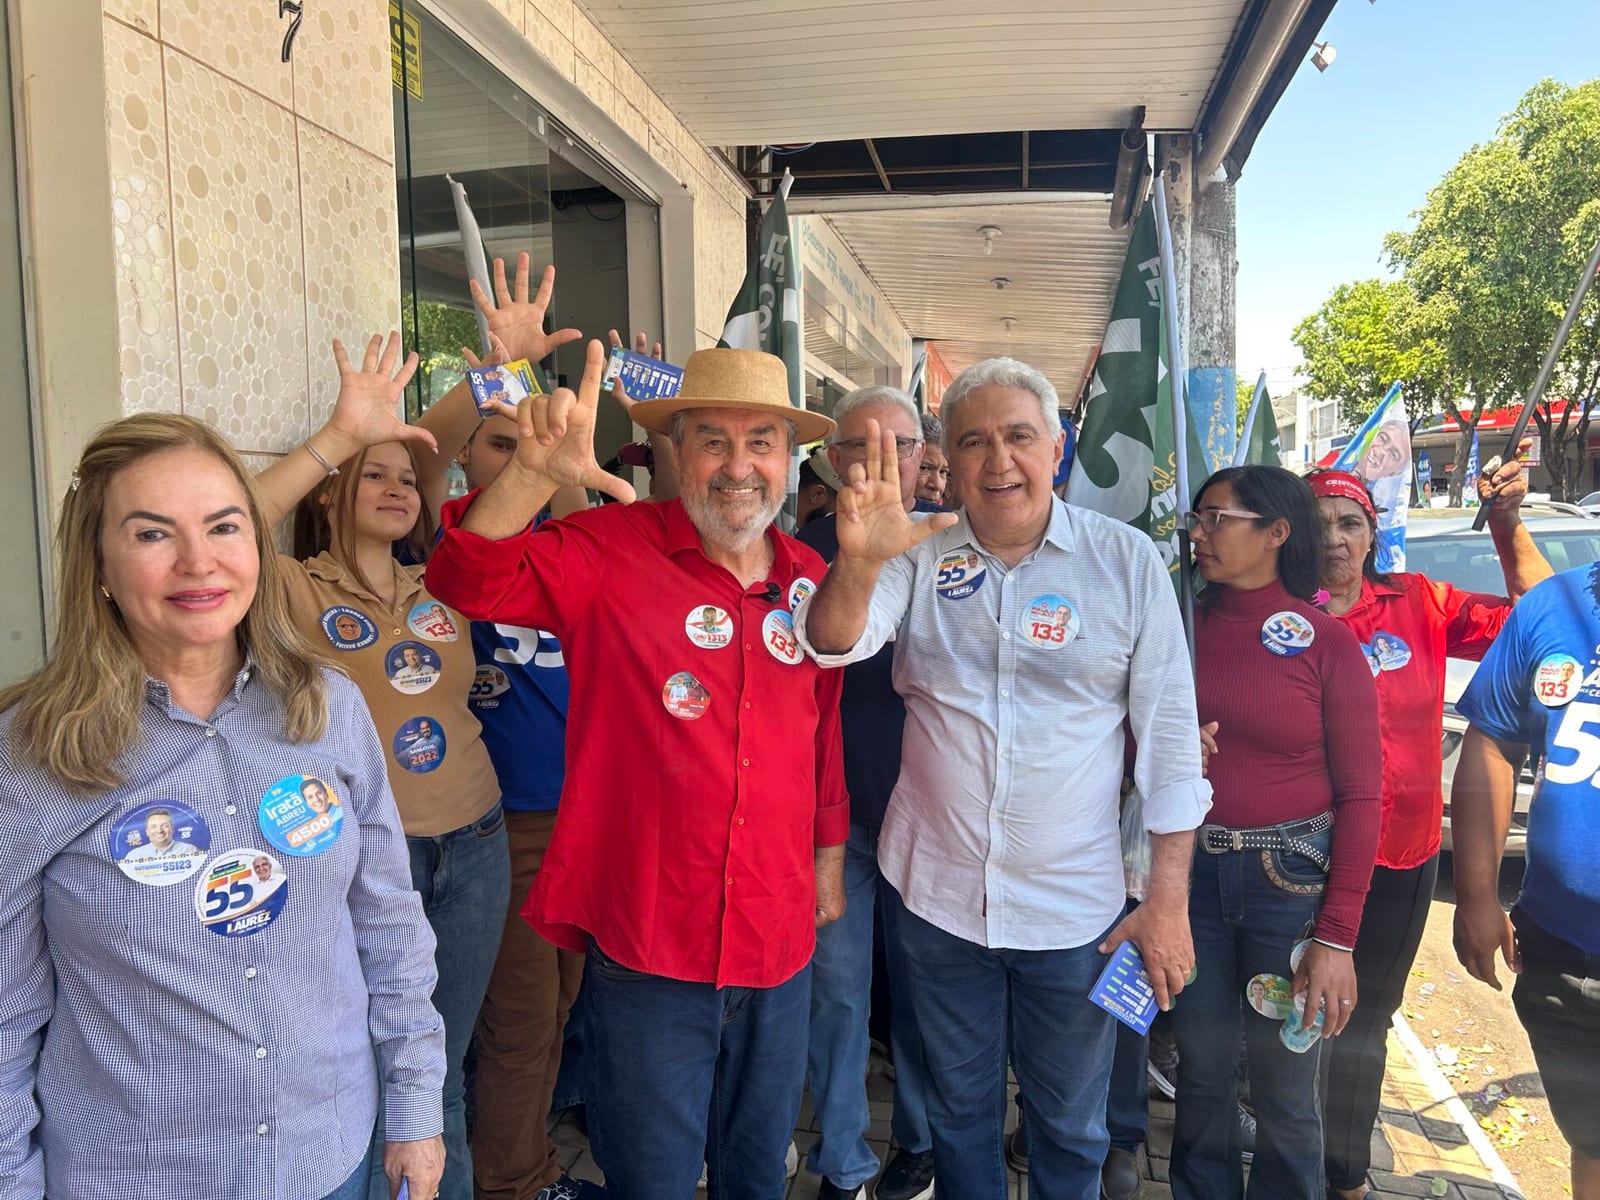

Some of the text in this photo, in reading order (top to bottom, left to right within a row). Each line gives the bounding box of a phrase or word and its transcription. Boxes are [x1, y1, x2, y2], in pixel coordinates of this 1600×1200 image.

[279, 0, 303, 62] 7
[937, 560, 967, 586] 55
[424, 620, 457, 638] 133
[1031, 621, 1066, 643] 133
[1266, 617, 1301, 642] 55
[769, 630, 797, 660] 133
[1540, 681, 1569, 699] 133
[410, 750, 438, 765] 2022
[276, 805, 307, 828] ABREU
[291, 815, 331, 844] 4500
[162, 859, 192, 872] 55123
[205, 868, 253, 918] 55
[226, 910, 272, 934] LAUREZ
